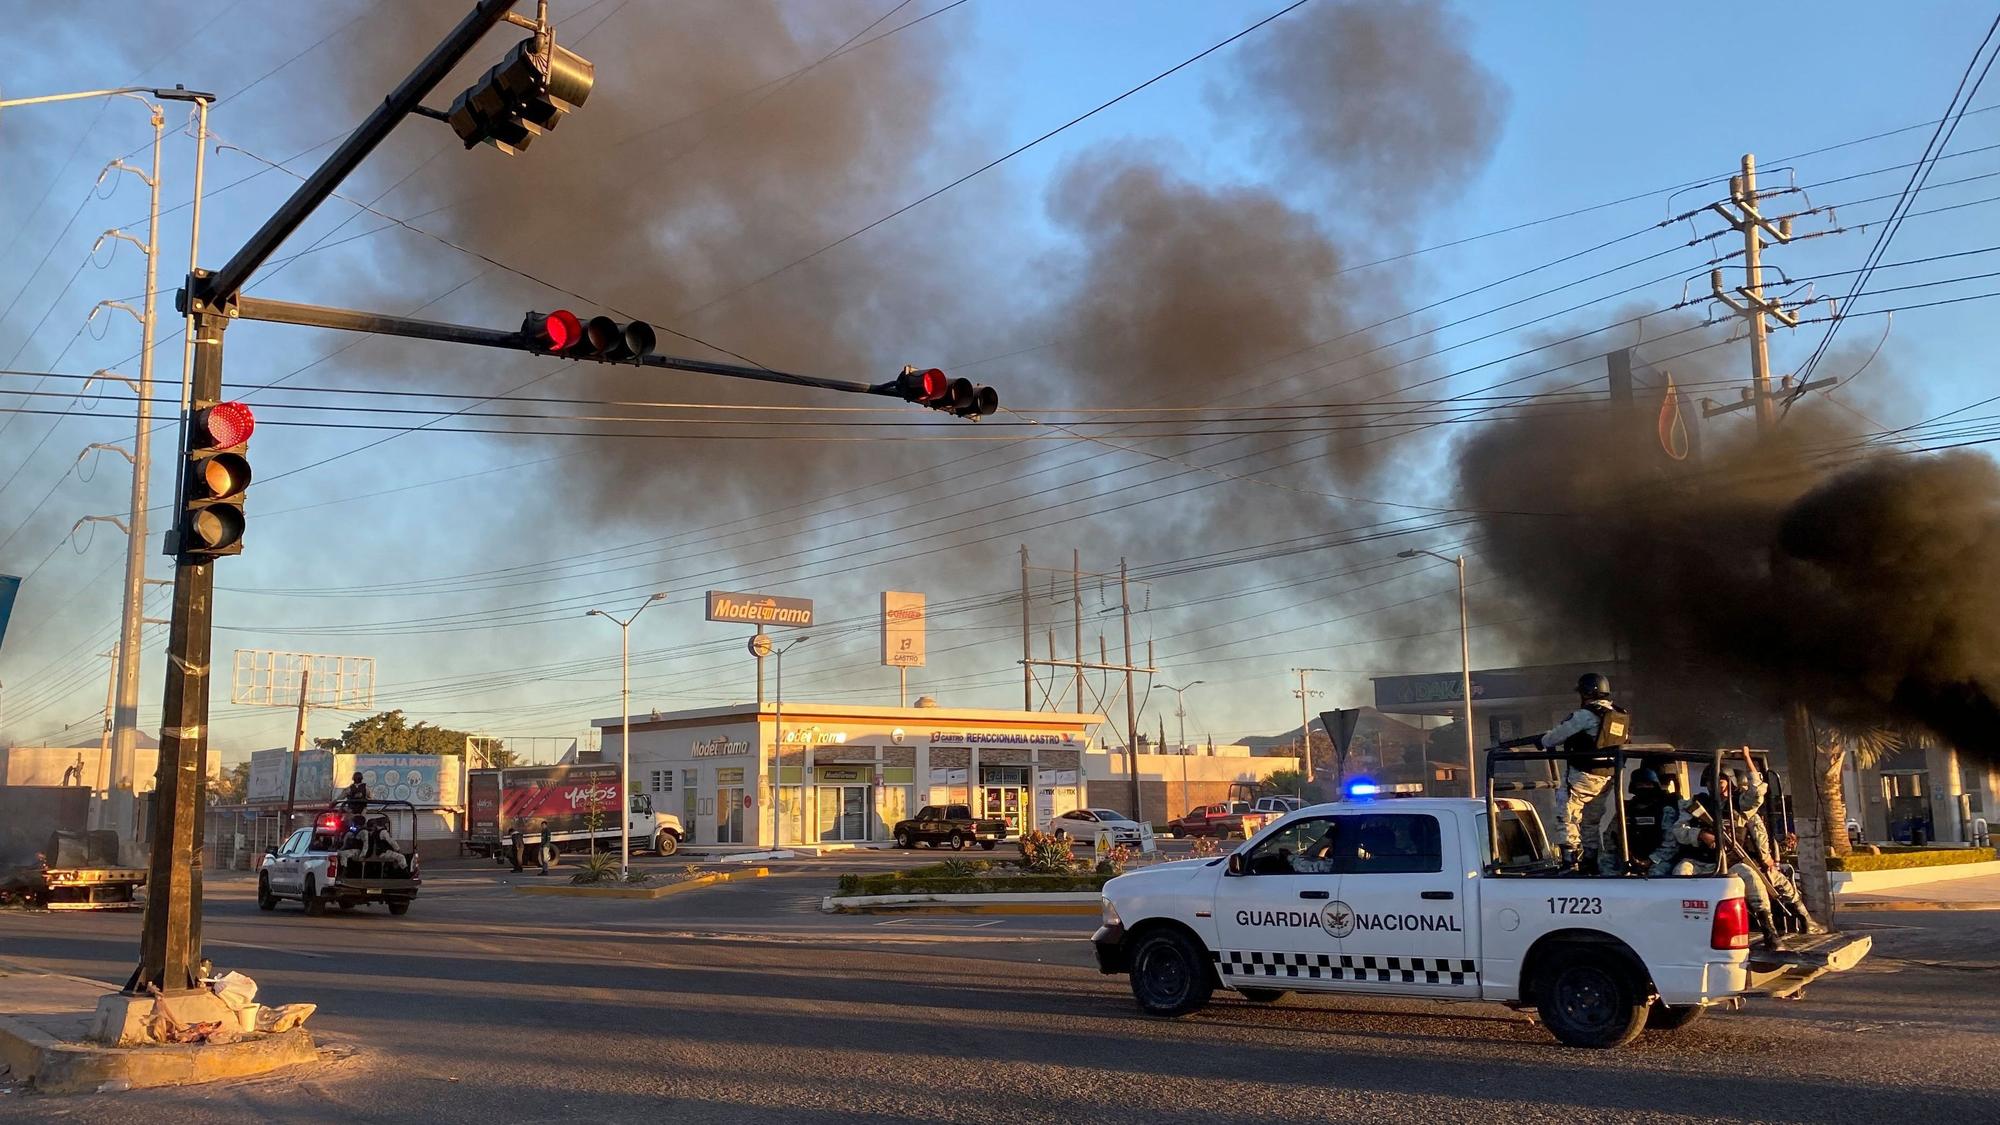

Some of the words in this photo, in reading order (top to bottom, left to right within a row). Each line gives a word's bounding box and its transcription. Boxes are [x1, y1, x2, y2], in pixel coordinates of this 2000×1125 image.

[894, 654, 919, 662] CASTRO
[967, 733, 1028, 744] REFACCIONARIA
[1030, 734, 1060, 745] CASTRO
[1547, 897, 1603, 914] 17223
[1236, 910, 1321, 928] GUARDIA
[1356, 913, 1462, 932] NACIONAL
